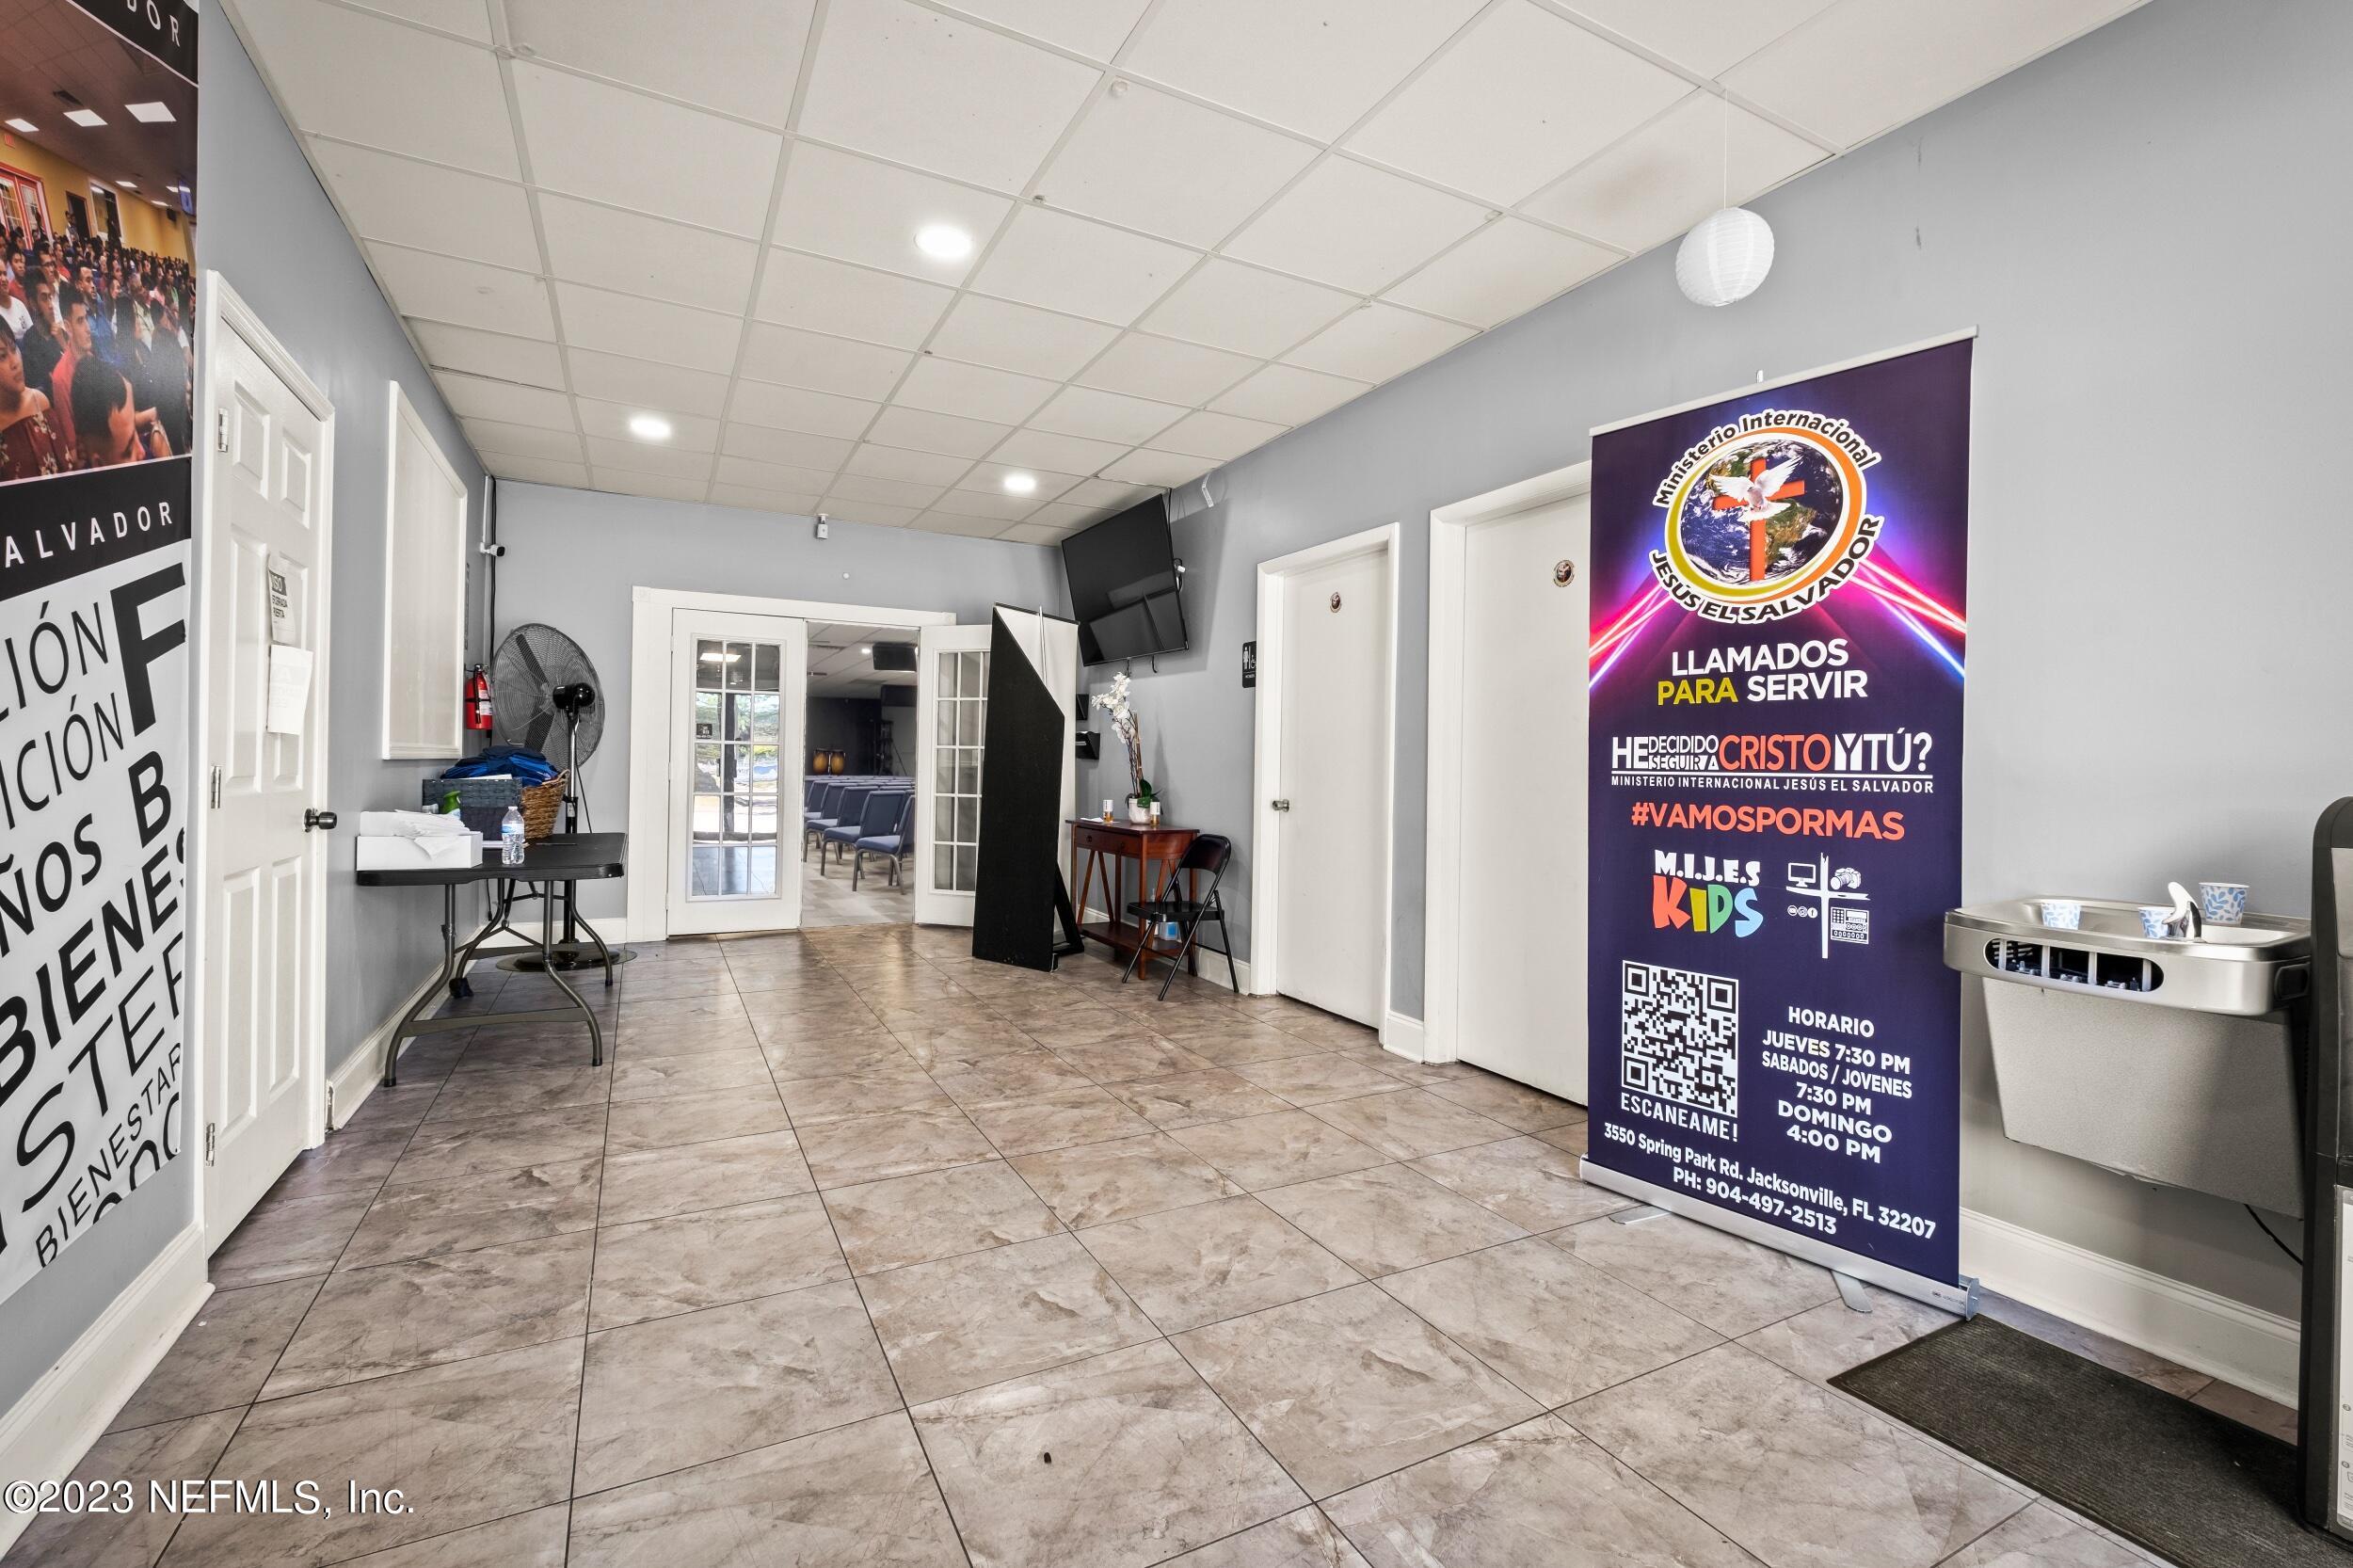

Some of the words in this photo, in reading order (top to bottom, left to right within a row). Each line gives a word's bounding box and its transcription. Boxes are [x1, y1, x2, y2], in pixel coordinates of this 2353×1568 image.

[1656, 426, 1737, 505] Ministerio
[1741, 411, 1877, 468] Internacional
[5, 501, 172, 568] ALVADOR
[1652, 552, 1702, 609] JESÚS
[1740, 517, 1880, 621] SALVADOR
[0, 600, 108, 722] IÓN
[1672, 638, 1849, 677] LLAMADOS
[1657, 677, 1738, 706] PARA
[1747, 669, 1868, 702] SERVIR
[1611, 736, 1648, 769] HE
[1648, 735, 1720, 754] DECIDIDO
[1719, 733, 1832, 771] CRISTO
[1611, 776, 1675, 788] MINISTERIO
[1678, 776, 1780, 790] INTERNACIONAL
[1783, 777, 1827, 792] JESÚS
[1831, 779, 1848, 792] EL
[1851, 779, 1934, 793] SALVADOR
[1631, 801, 1906, 841] #VAMOSPORMAS
[1652, 874, 1764, 938] KIDS
[0, 826, 184, 1108] BIENE
[1788, 1006, 1875, 1037] HORARIO
[1762, 1030, 1830, 1058] JUEVES
[1834, 1043, 1876, 1067] 7:30
[1881, 1052, 1911, 1074] PM
[1762, 1050, 1829, 1080] SABADOS
[1831, 1064, 1839, 1084] /
[1842, 1068, 1913, 1099] JOVENES
[1621, 1092, 1738, 1143] ESCANEAME!
[1778, 1099, 1893, 1144] DOMINGO
[1796, 1081, 1837, 1106] 7:30
[1842, 1093, 1871, 1115] PM
[1786, 1124, 1840, 1151] 4:00
[1846, 1138, 1881, 1163] PM
[1604, 1122, 1636, 1146] 3550
[1638, 1132, 1682, 1163] Spring
[1685, 1146, 1717, 1172] Park
[1720, 1157, 1743, 1180] Rd.
[1746, 1167, 1849, 1216] Jacksonville,
[1852, 1197, 1874, 1222] FL
[1878, 1206, 1936, 1240] 32207
[1673, 1165, 1702, 1191] PH:
[1705, 1177, 1837, 1235] 904-497-2513
